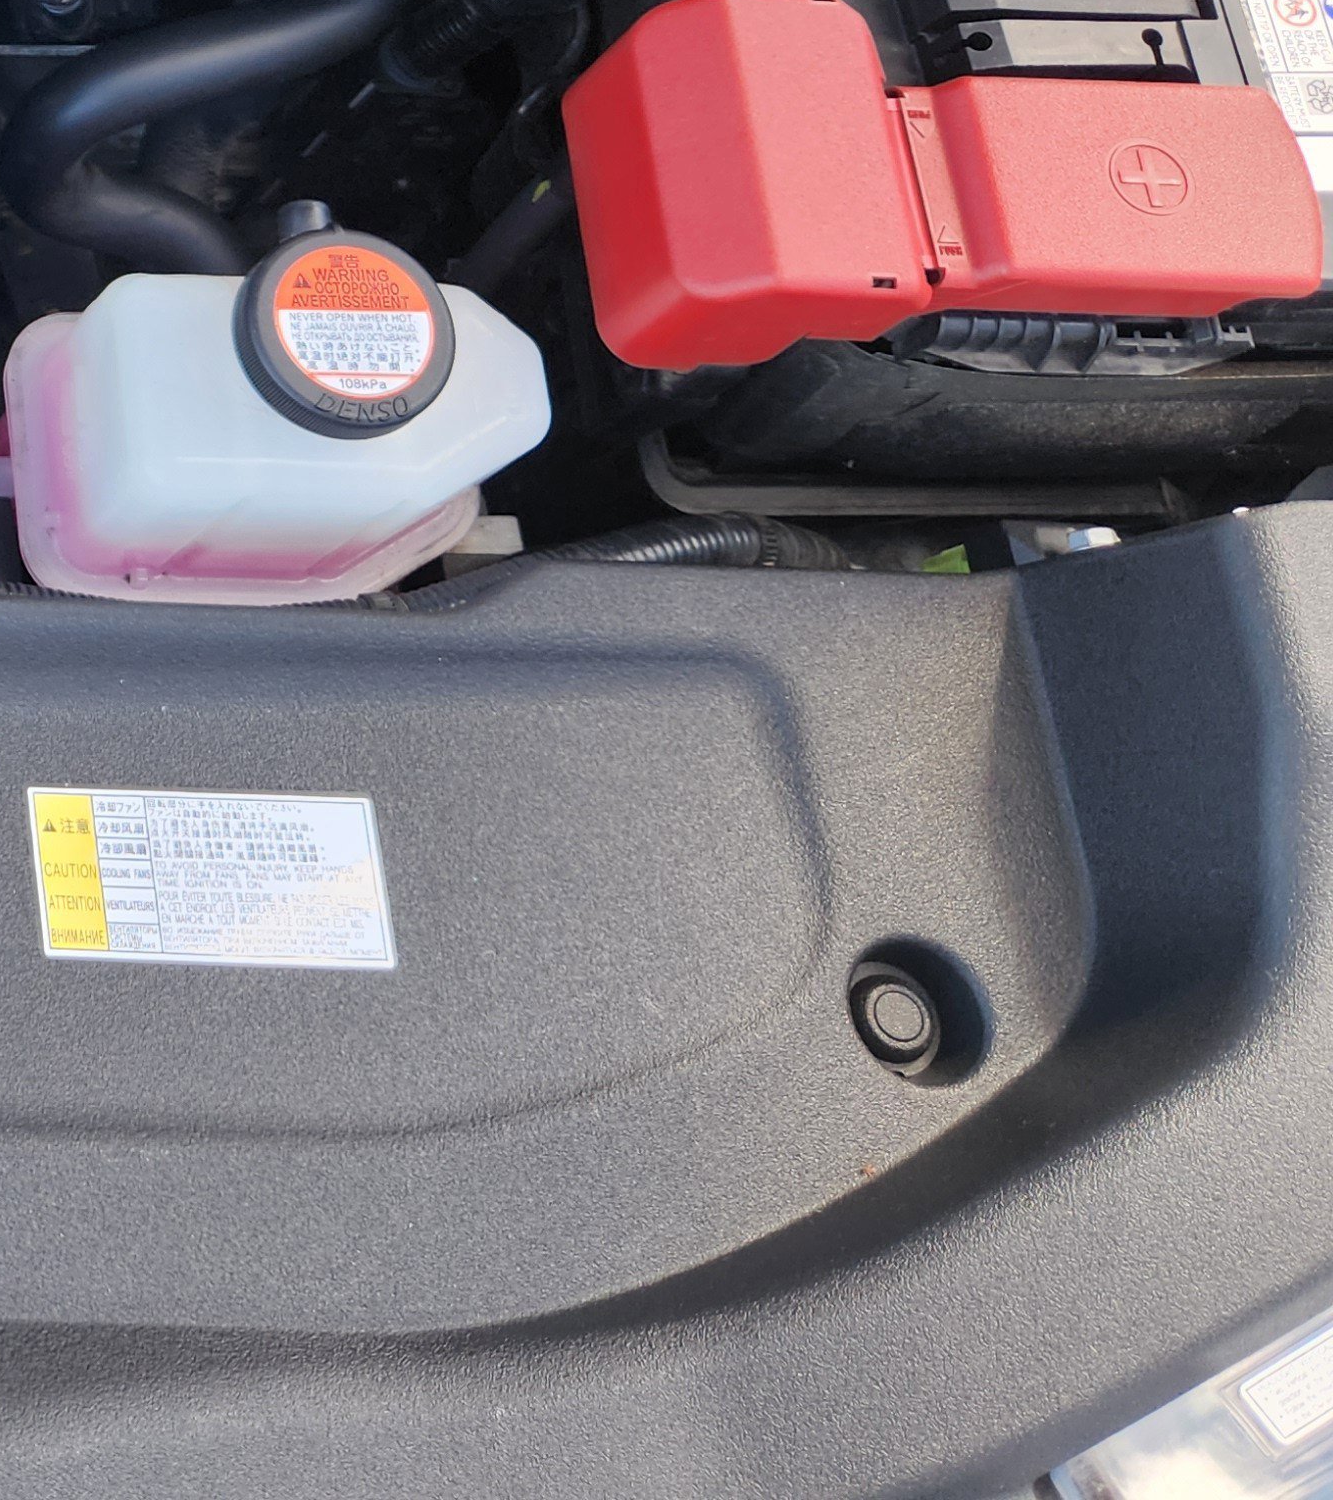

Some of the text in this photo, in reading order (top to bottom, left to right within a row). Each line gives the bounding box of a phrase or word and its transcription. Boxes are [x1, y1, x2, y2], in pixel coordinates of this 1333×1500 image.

[1252, 2, 1265, 17] NOT
[1291, 29, 1308, 54] REACH
[1314, 29, 1328, 48] KEEP
[1280, 29, 1301, 67] CHILDREN
[1307, 42, 1319, 55] THE
[1285, 76, 1310, 128] BATTERY MUST
[313, 268, 389, 282] WARNING
[315, 281, 400, 296] ОСТОРОЖНО
[291, 294, 409, 309] AVERTISSEMENT
[289, 312, 388, 322] NEVER OPEN WHEN
[290, 322, 300, 330] NE
[307, 322, 337, 330] JAMAIS
[340, 323, 373, 331] OUVRIR
[339, 378, 388, 389] 108kPa
[313, 392, 410, 423] DENSO
[96, 802, 141, 813] 冷却ファン
[60, 818, 91, 834] 注意
[44, 862, 97, 879] CAUTION
[102, 868, 152, 880] COOLING FANS
[49, 894, 101, 911] ATTENTION
[106, 900, 156, 912] VENTILATEURS
[50, 927, 106, 946] ВНИМАНИЕ
